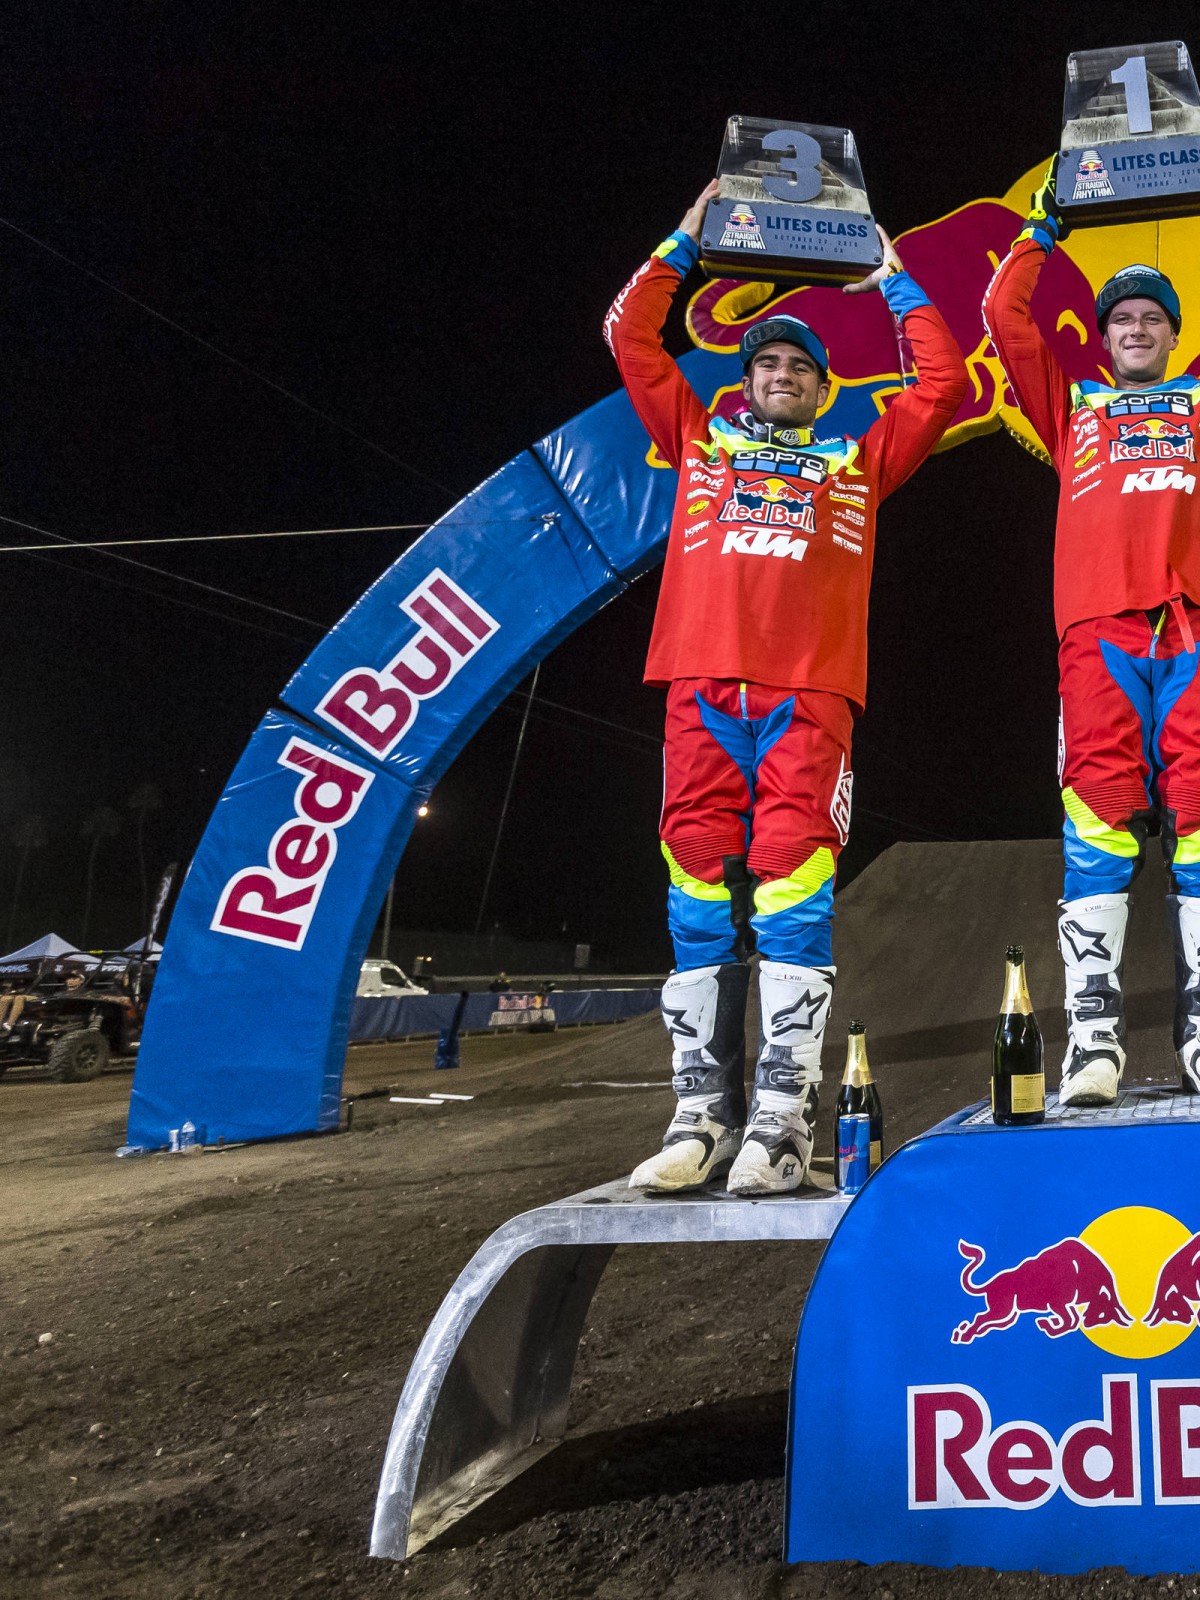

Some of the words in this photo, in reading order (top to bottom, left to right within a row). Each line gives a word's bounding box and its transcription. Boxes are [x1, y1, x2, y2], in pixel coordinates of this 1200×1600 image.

[1110, 56, 1153, 134] 1
[761, 129, 822, 203] 3
[1113, 154, 1156, 172] LITES
[1076, 188, 1113, 200] RHYTHM
[1077, 180, 1109, 191] STRAIGHT
[724, 231, 761, 243] STRAIGHT
[766, 215, 813, 233] LITES
[816, 220, 868, 238] CLASS
[722, 239, 763, 250] RHYTHM
[1108, 394, 1190, 407] GoPro
[735, 450, 824, 471] GoPro
[1111, 439, 1156, 462] Red
[1120, 465, 1197, 495] KTM
[720, 500, 766, 523] Red
[770, 505, 816, 533] Bull
[720, 525, 809, 562] KTM
[217, 742, 370, 945] Red
[321, 573, 495, 757] Bull
[911, 1379, 1138, 1506] Red
